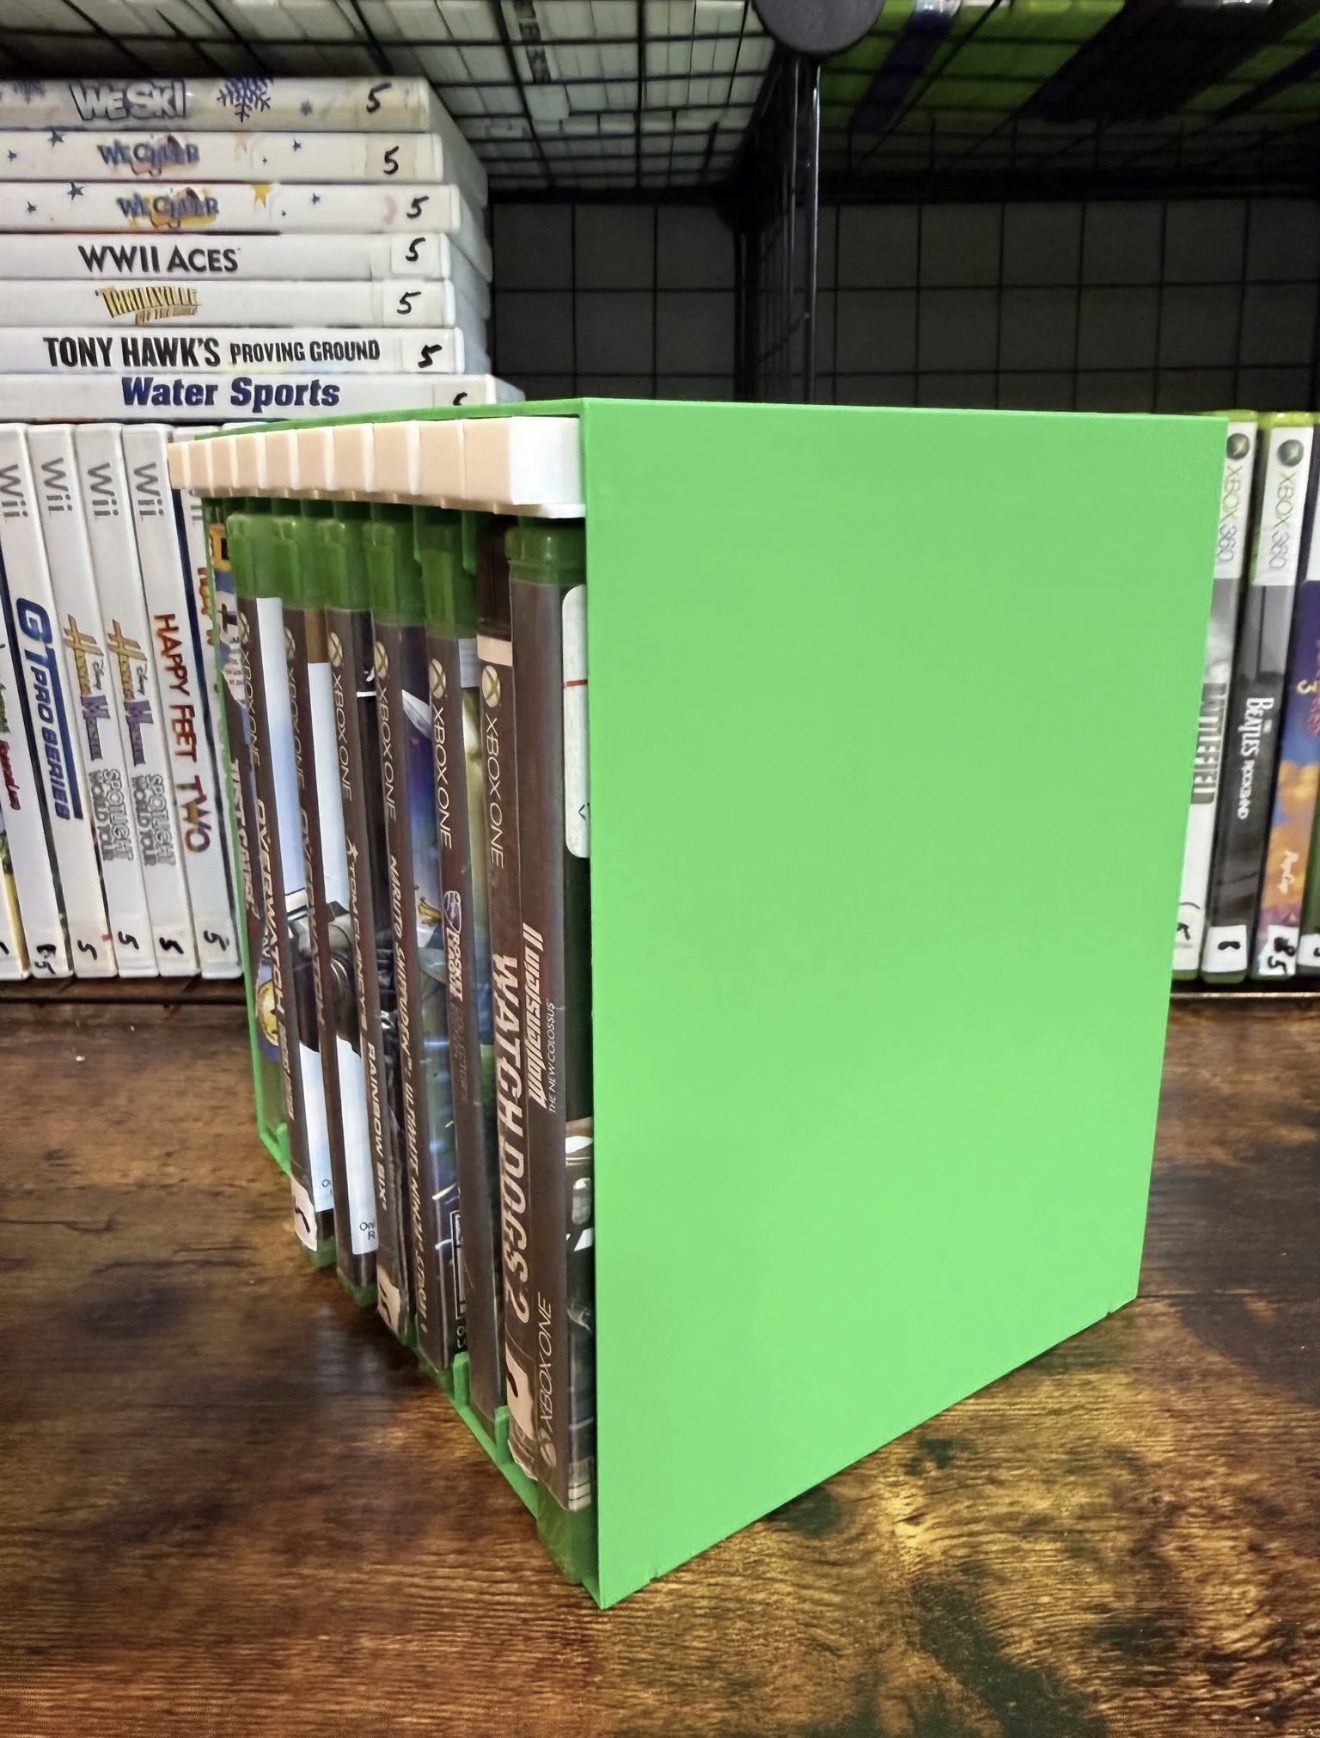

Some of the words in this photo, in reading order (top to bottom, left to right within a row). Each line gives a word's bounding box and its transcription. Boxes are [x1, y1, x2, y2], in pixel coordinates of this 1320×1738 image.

[366, 82, 392, 113] 5
[383, 146, 399, 175] 5
[407, 196, 430, 219] 5
[78, 245, 161, 273] WWII
[167, 245, 238, 273] ACES
[405, 237, 426, 262] 5
[396, 292, 422, 315] 5
[43, 337, 113, 367] TONY
[121, 337, 221, 367] HAWK'S
[230, 342, 306, 365] PROVING
[309, 339, 381, 362] GROUND
[418, 344, 443, 369] 5
[121, 376, 218, 406] Water
[230, 376, 340, 414] Sports
[0, 464, 28, 518] Wii
[41, 457, 73, 511] Wii
[87, 463, 119, 516] Wii
[133, 463, 164, 516] Wii
[1222, 465, 1242, 521] XBOX
[1274, 471, 1297, 530] XBOX
[153, 613, 190, 697] HAPPY
[31, 666, 54, 723] PRO
[333, 672, 348, 744] XBOX
[1297, 680, 1317, 694] 3
[169, 704, 197, 762] FEET
[377, 686, 393, 761] XBOX
[431, 705, 448, 784] XBOX
[1238, 697, 1274, 758] BEATLES
[42, 727, 70, 820] SERIES
[339, 747, 353, 801] ONE
[485, 711, 502, 799] XBOX
[176, 774, 212, 853] TWO
[383, 764, 396, 822] ONE
[437, 788, 452, 850] ONE
[489, 802, 504, 869] ONE
[256, 798, 285, 1014] OVERWATCH
[390, 855, 402, 939] NARUTO
[453, 932, 463, 1001] ROCKET
[349, 864, 359, 917] TOM
[367, 1041, 384, 1158] RAINBOW
[524, 945, 547, 1109] Wolfenstein
[547, 1002, 556, 1062] COLOSSUS
[492, 954, 523, 1137] WATCH
[501, 1137, 527, 1280] DOGS
[506, 1277, 529, 1323] 2
[538, 1292, 551, 1357] ONE
[539, 1352, 553, 1433] XBOX
